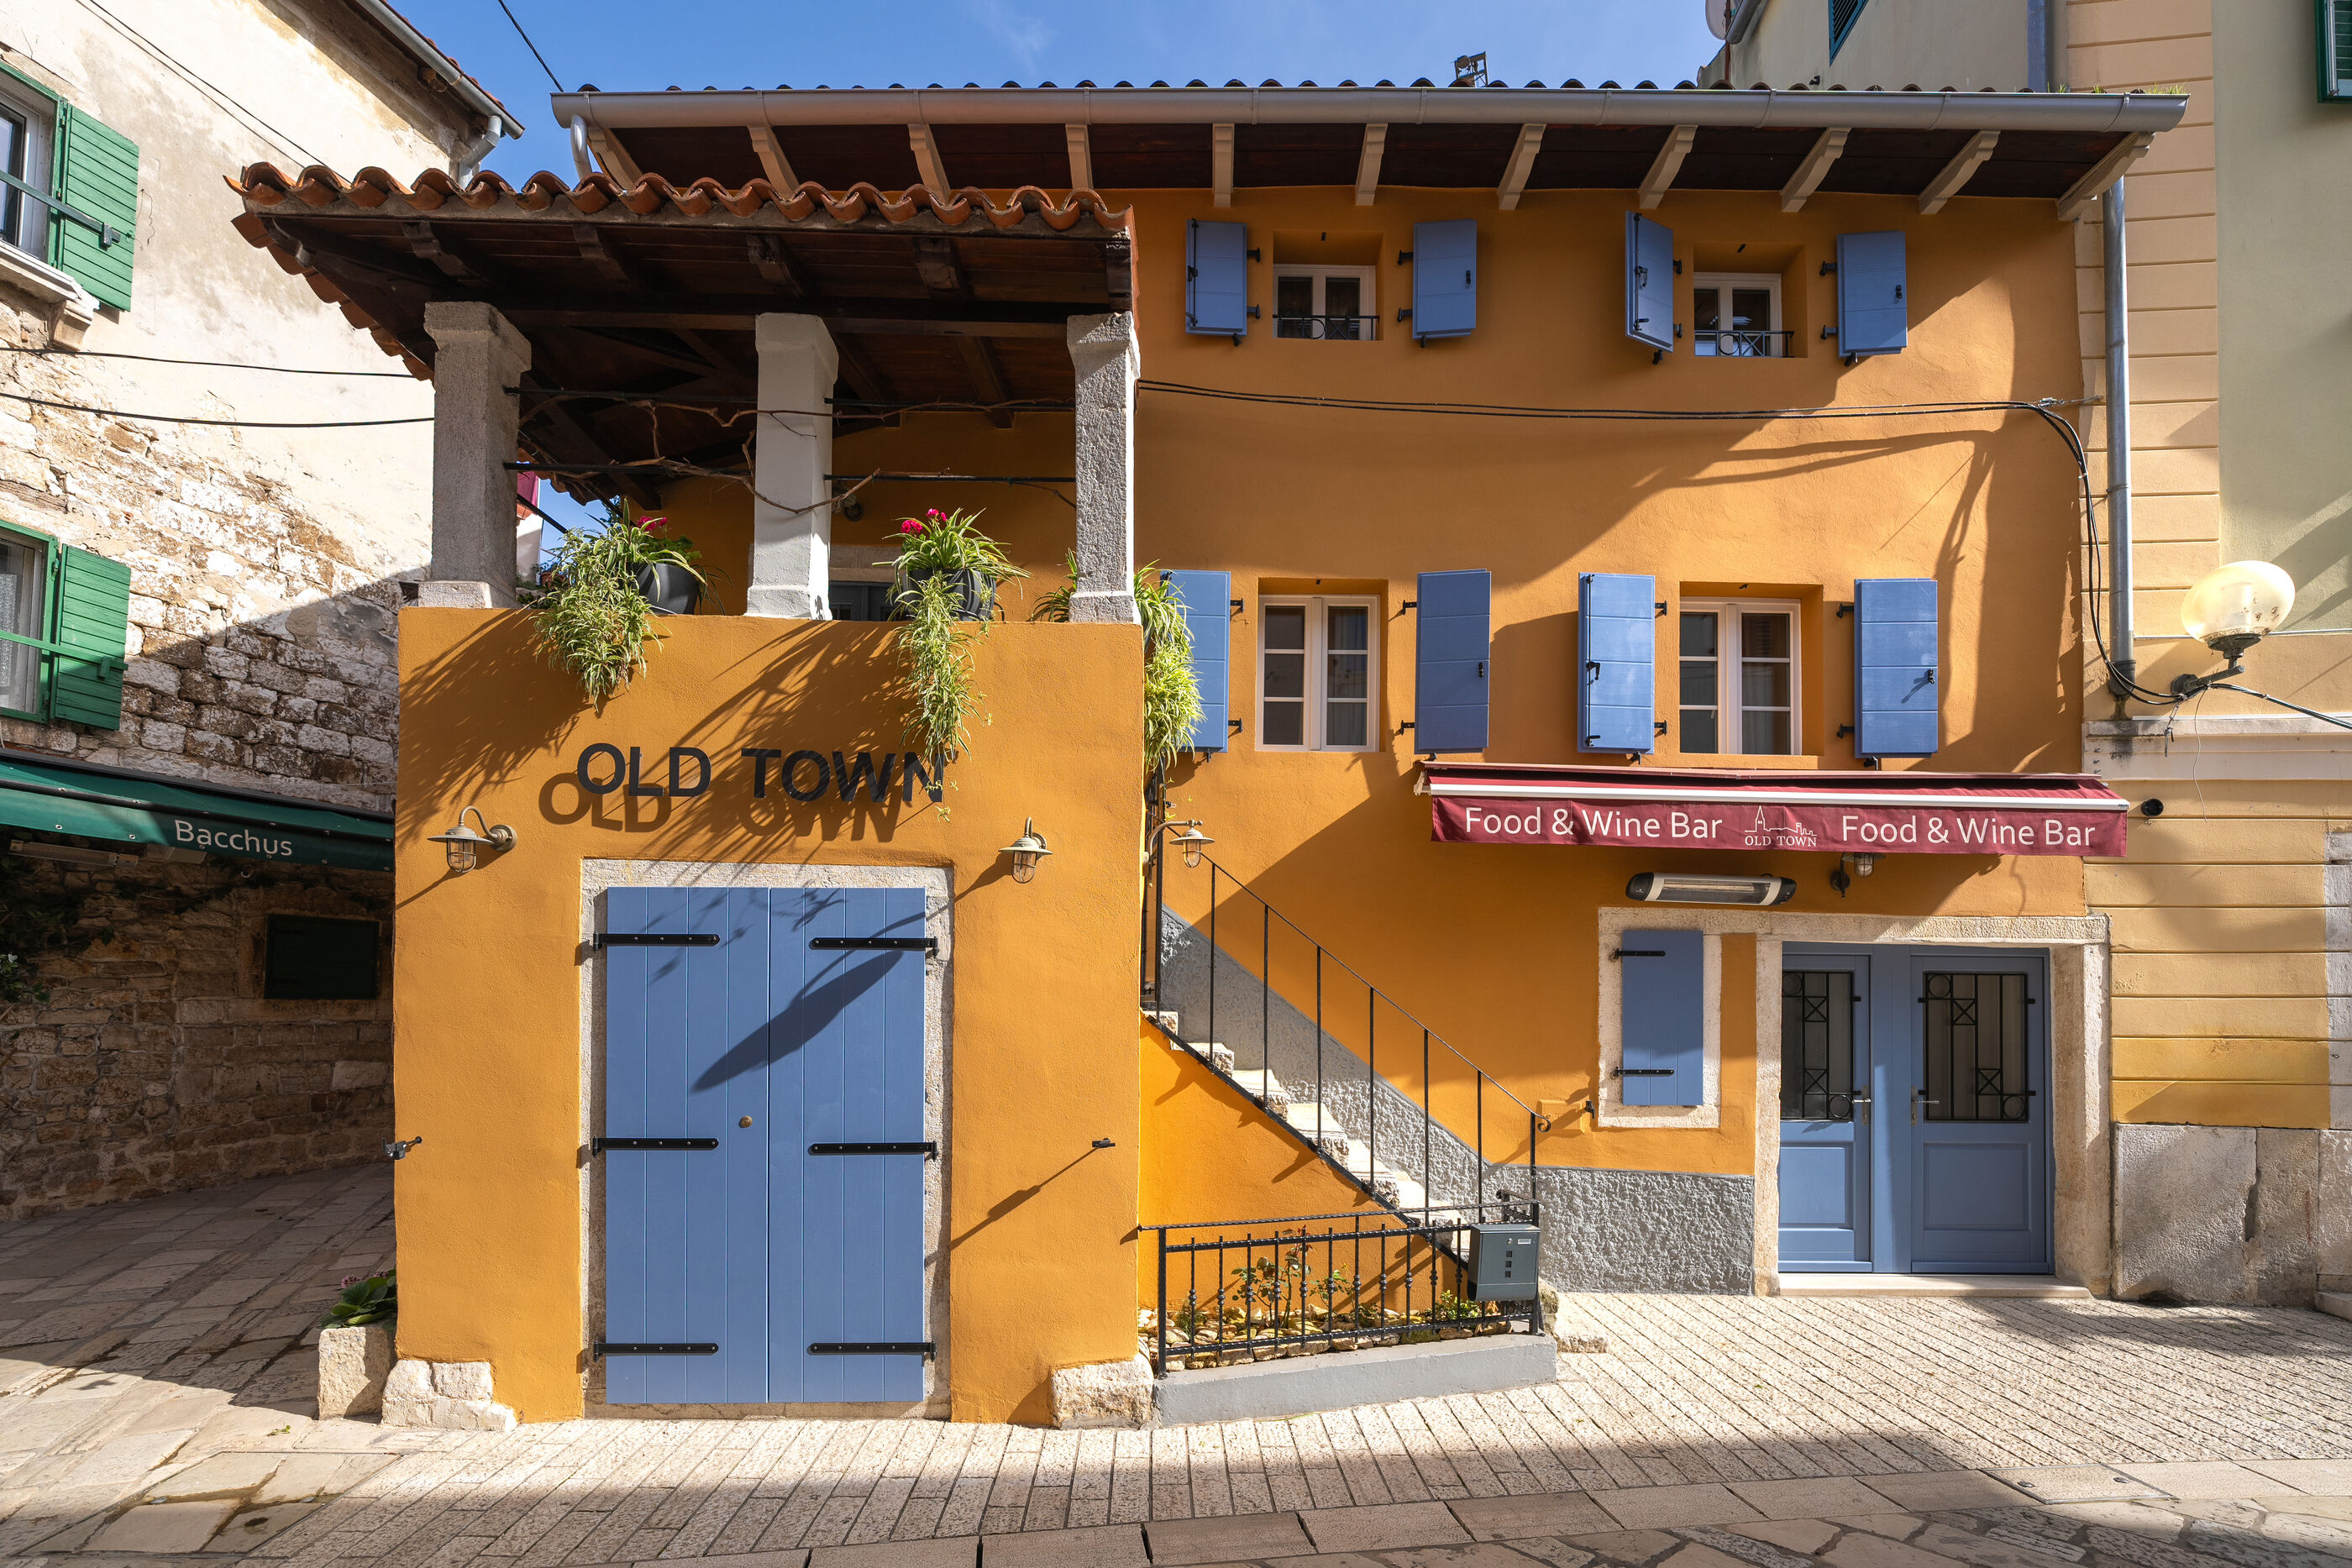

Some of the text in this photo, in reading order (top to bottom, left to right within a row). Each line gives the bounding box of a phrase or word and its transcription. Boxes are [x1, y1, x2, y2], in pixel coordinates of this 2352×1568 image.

[577, 742, 945, 802] OLD TOWN
[174, 819, 294, 857] Bacchus
[1465, 806, 1723, 839] Food & Wine Bar
[1842, 815, 2096, 847] Food & Wine Bar
[1745, 835, 1817, 847] OLD TOWN
